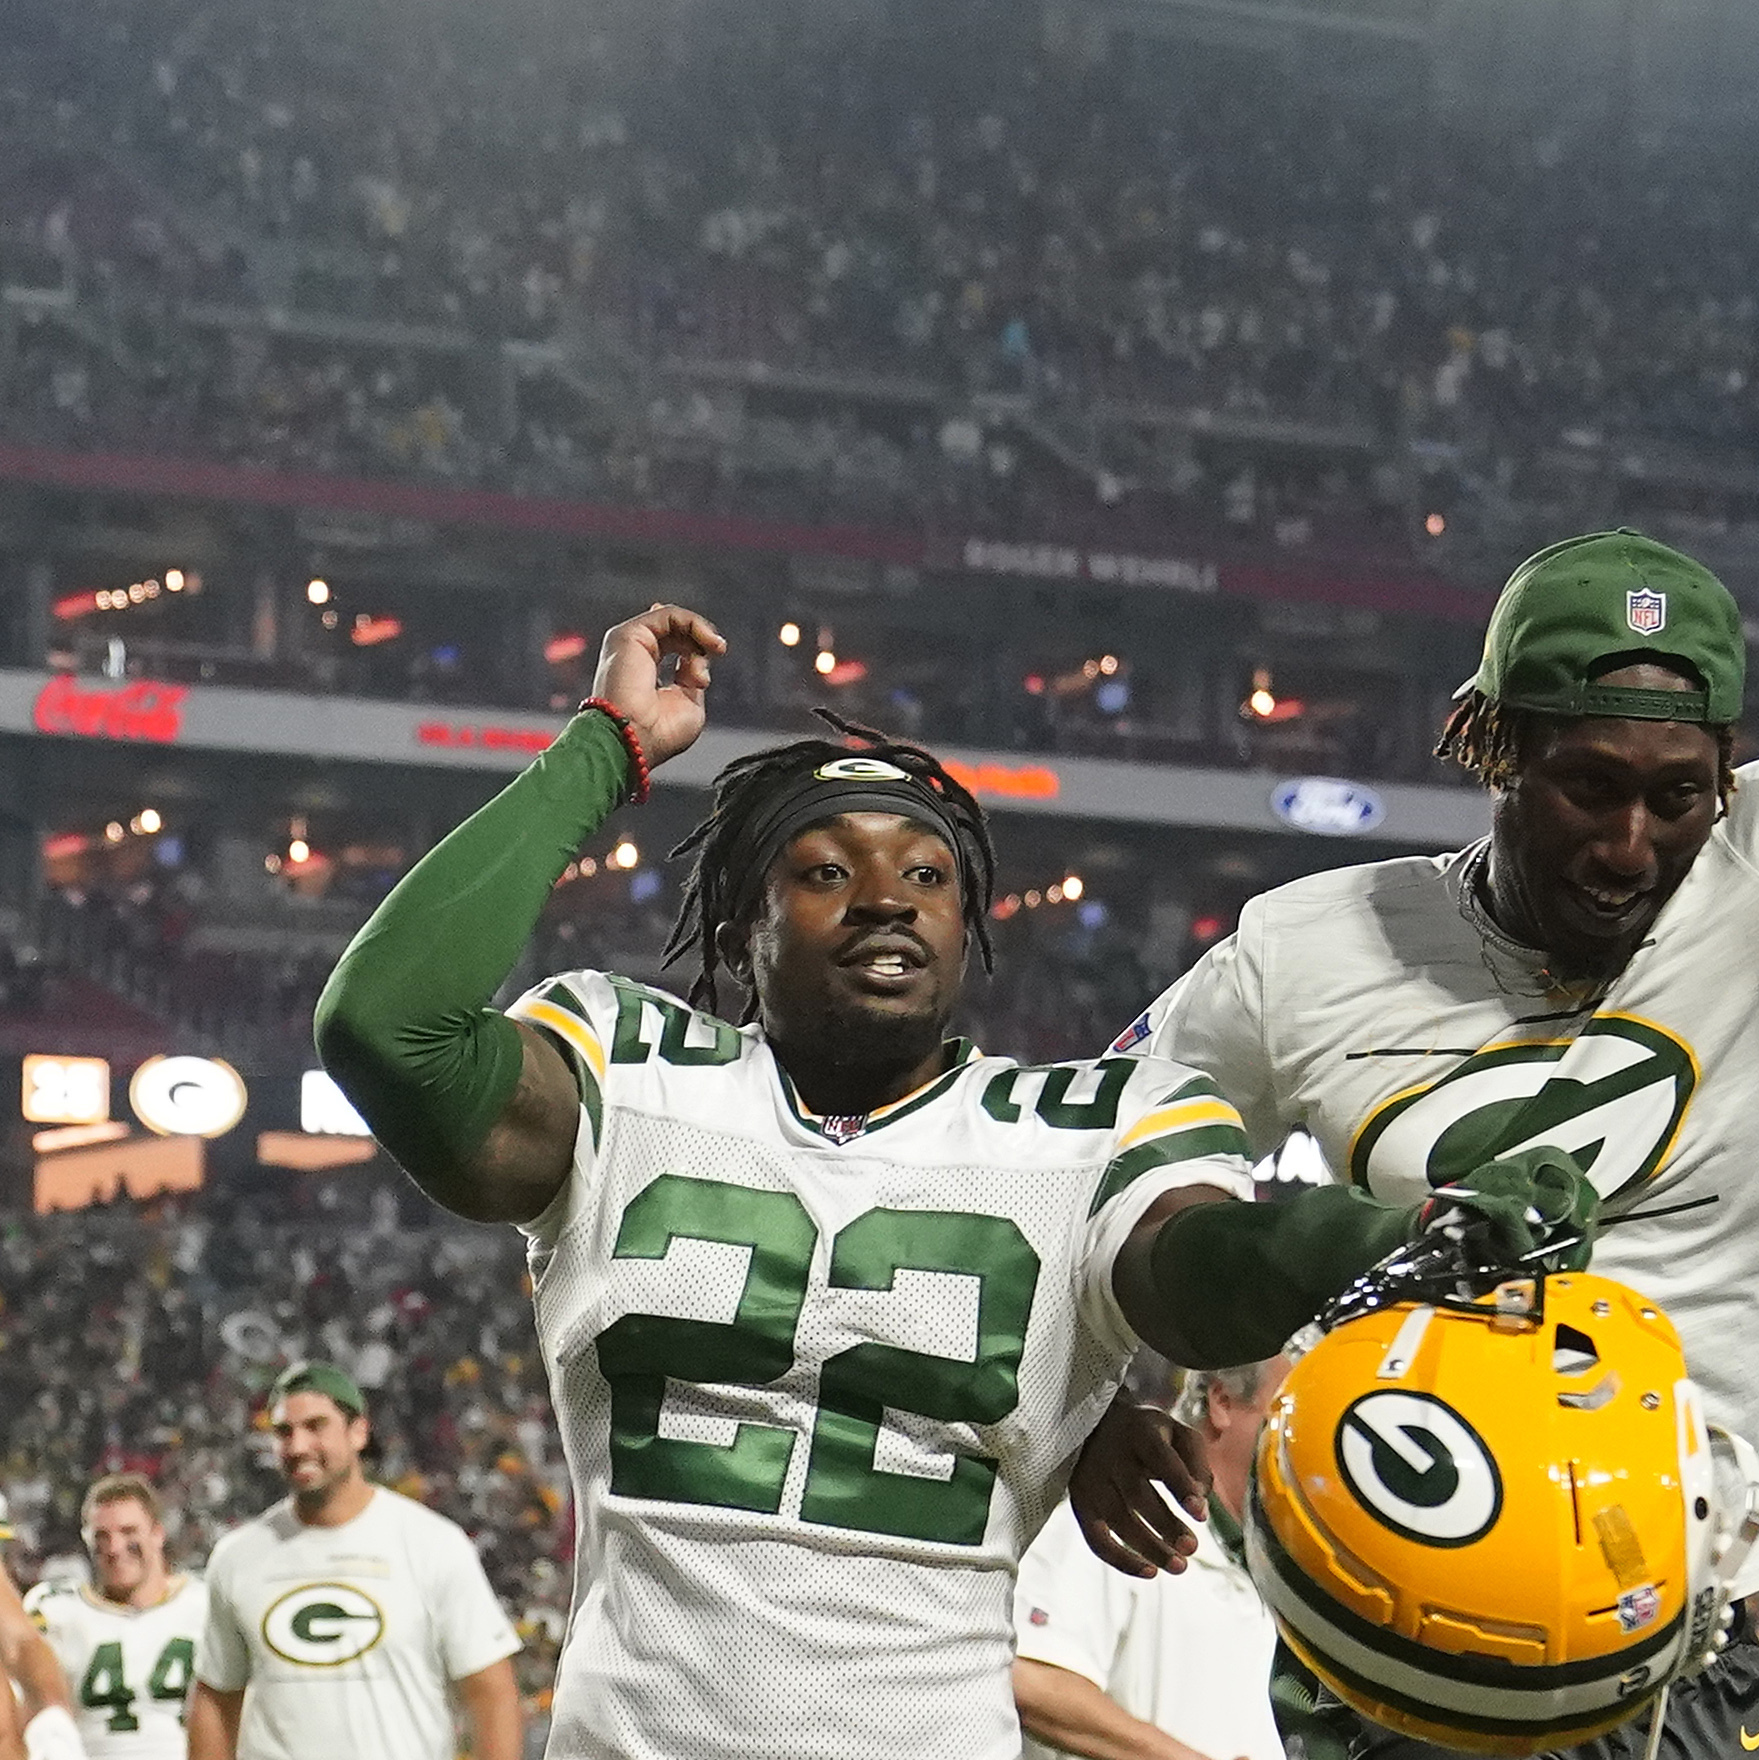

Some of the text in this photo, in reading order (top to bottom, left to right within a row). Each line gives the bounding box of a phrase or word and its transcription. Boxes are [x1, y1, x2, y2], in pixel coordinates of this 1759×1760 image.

[1633, 609, 1659, 627] NFL
[595, 1173, 1042, 1547] 22
[81, 1637, 195, 1732] 44
